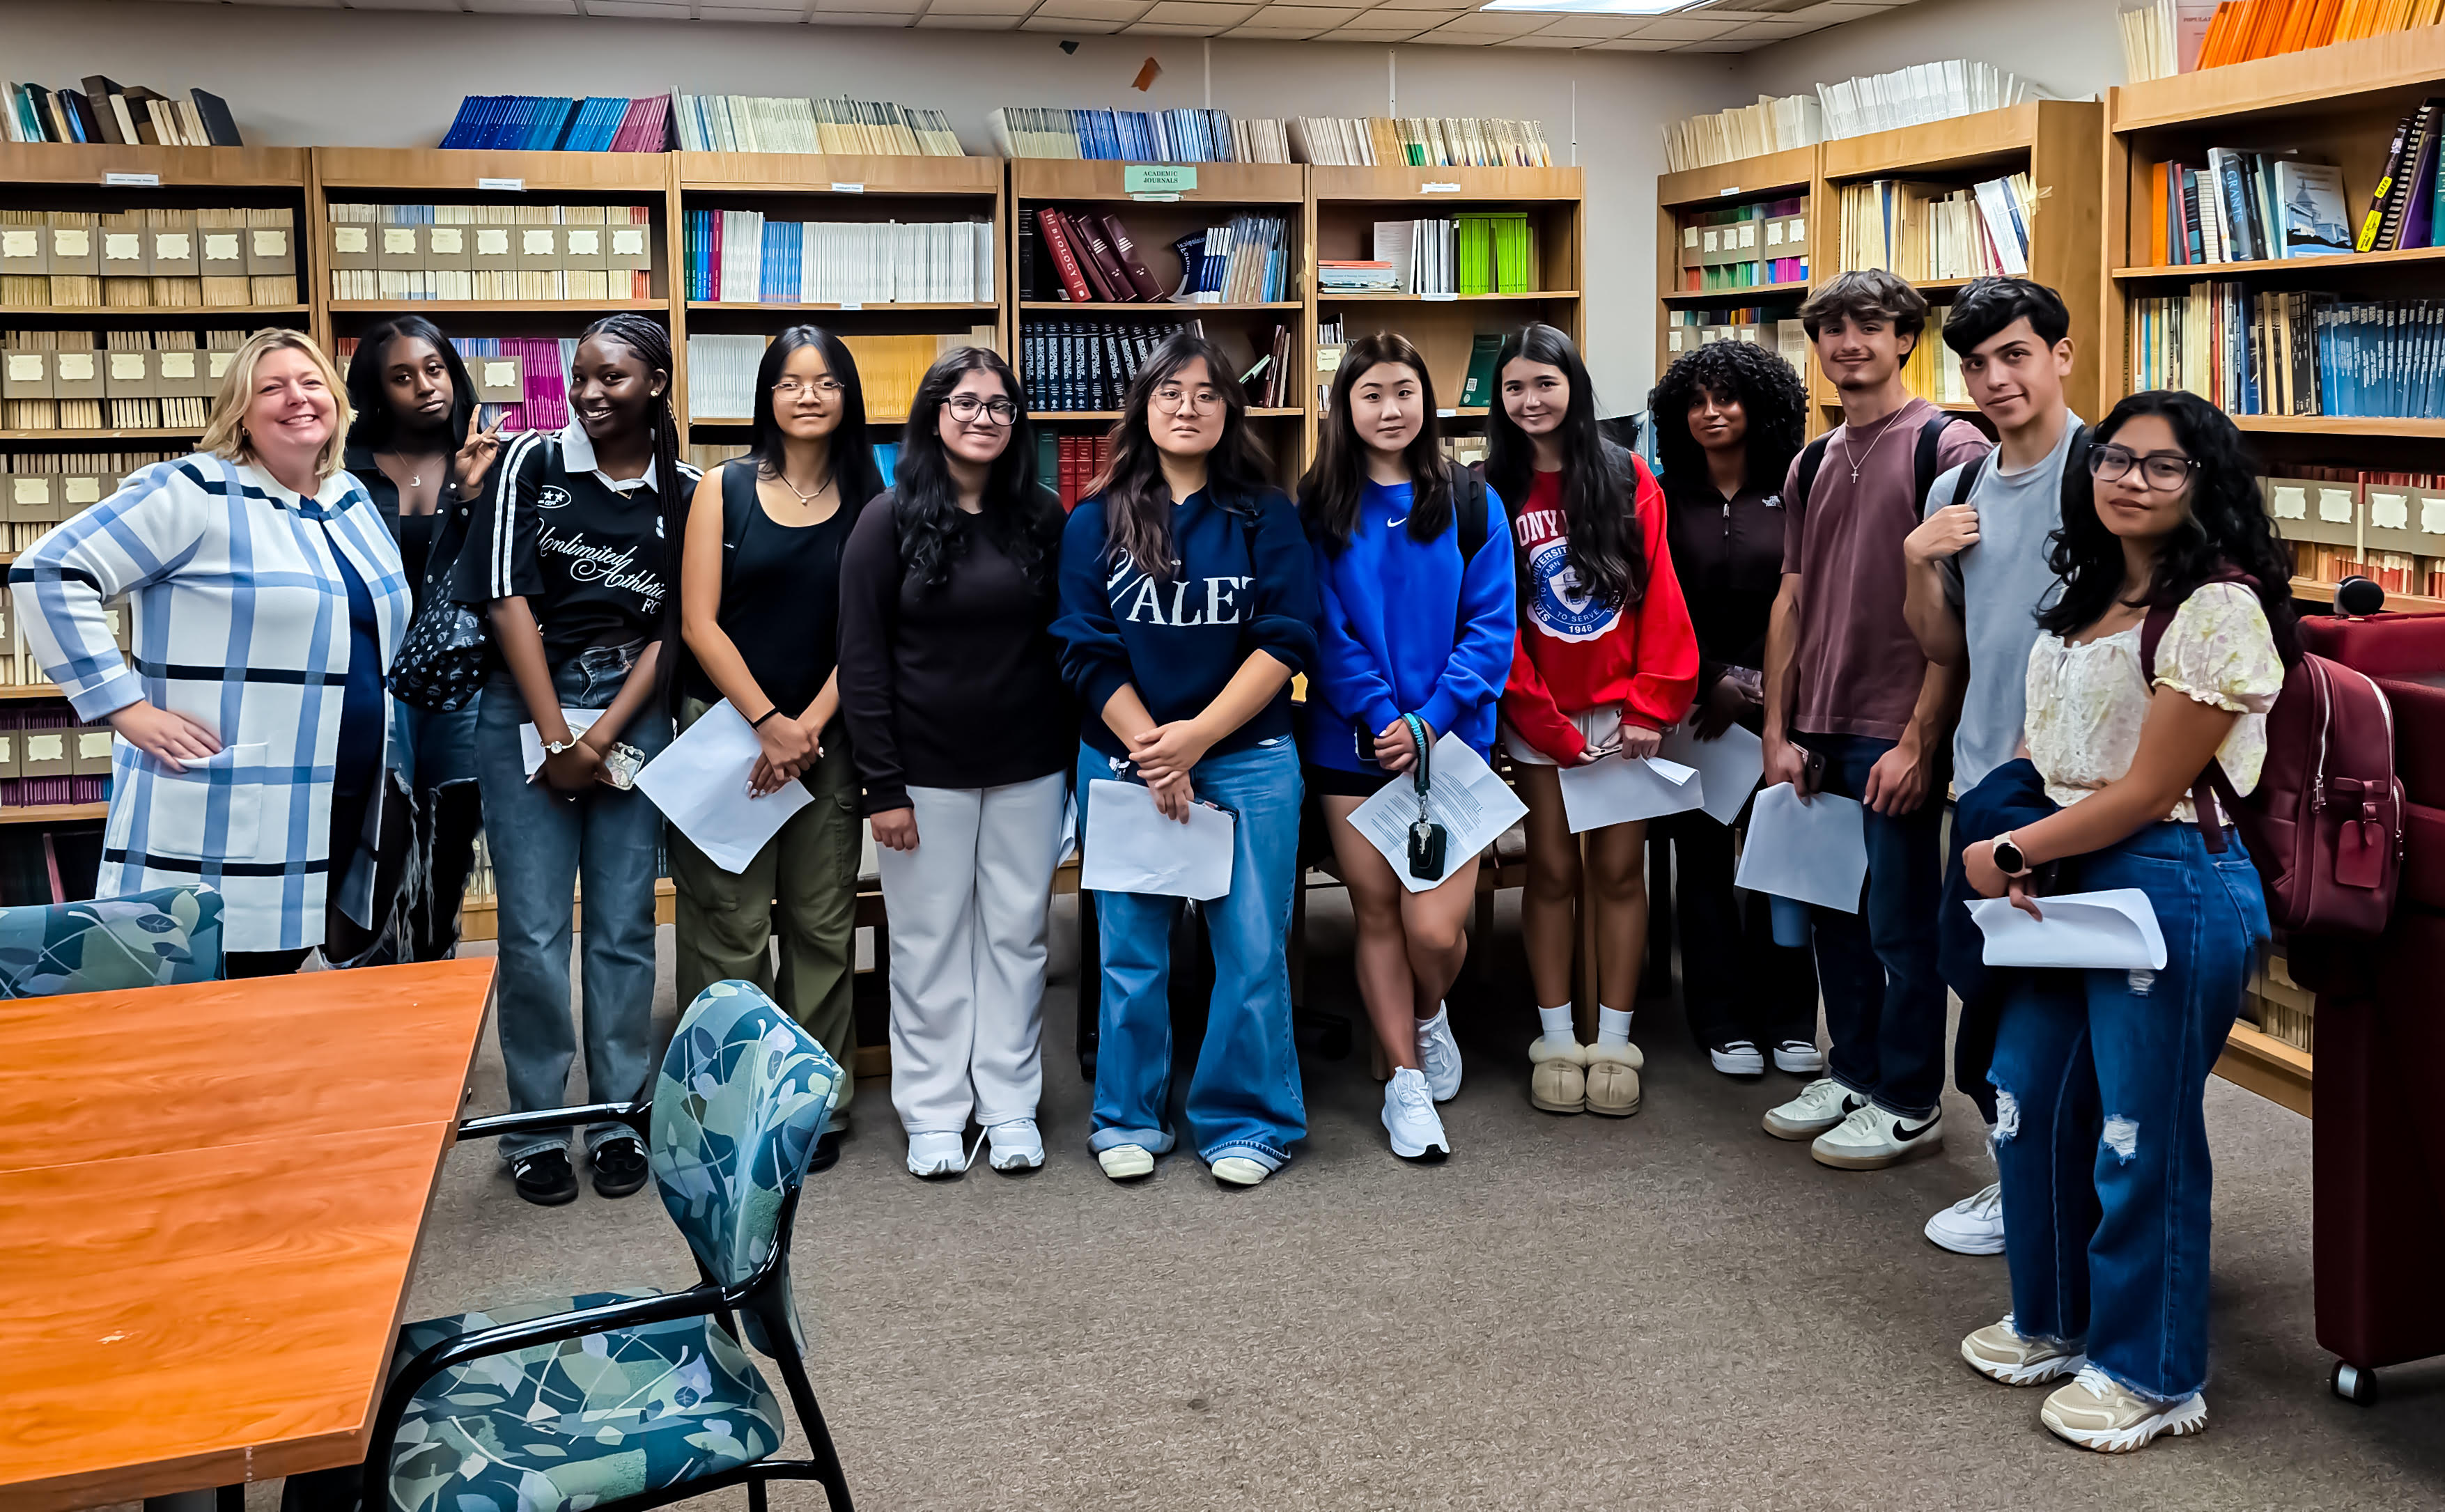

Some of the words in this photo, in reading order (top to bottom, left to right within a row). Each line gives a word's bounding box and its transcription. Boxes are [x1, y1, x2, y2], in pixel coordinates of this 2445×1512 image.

[2226, 170, 2243, 224] GRANTS
[2377, 179, 2389, 195] USED
[1051, 228, 1078, 277] BIOLOGY
[536, 517, 638, 567] Unlimited
[1516, 510, 1558, 547] ONY
[1532, 546, 1569, 585] UNIVERSIT
[1542, 560, 1561, 584] LEARN
[641, 598, 661, 614] FC
[1557, 611, 1567, 620] TO
[1571, 609, 1599, 622] SERVE
[1569, 624, 1592, 634] 1948
